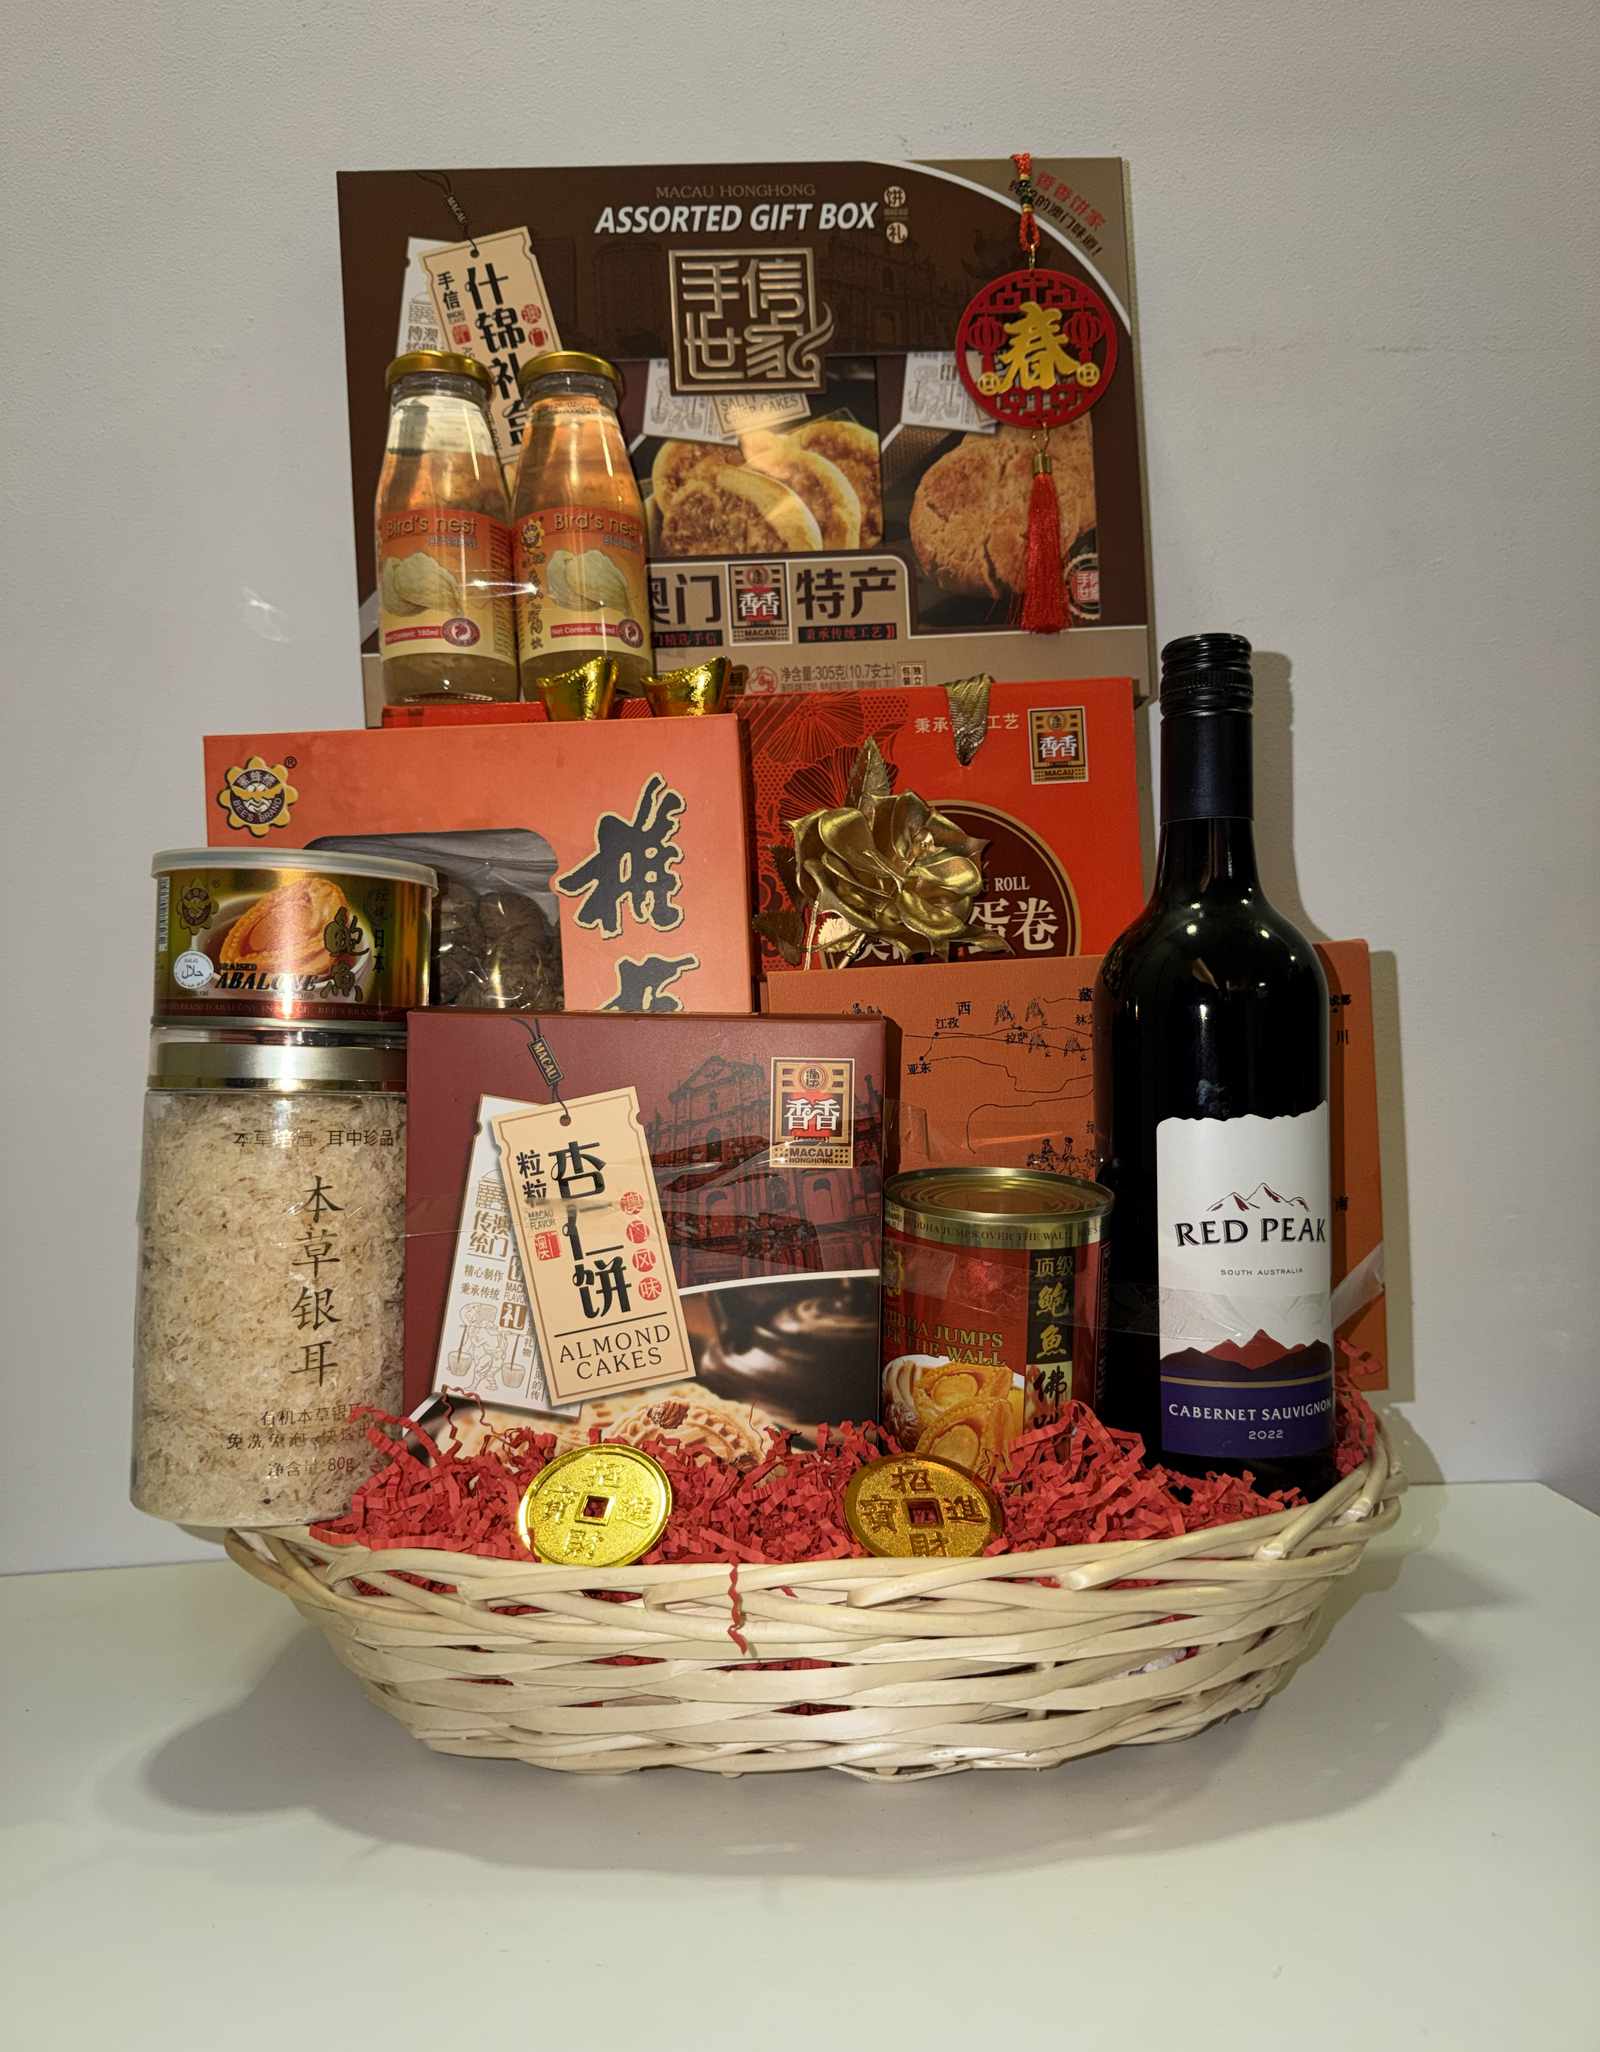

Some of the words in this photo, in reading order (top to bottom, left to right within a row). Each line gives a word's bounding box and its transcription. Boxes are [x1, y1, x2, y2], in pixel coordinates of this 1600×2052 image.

[656, 186, 714, 198] MACAU
[720, 184, 816, 197] HONGHONG
[447, 197, 467, 223] MACAU
[595, 205, 742, 233] ASSORTED
[750, 203, 812, 231] GIFT
[819, 202, 878, 230] BOX
[437, 271, 460, 310] 手信
[1000, 302, 1080, 393] 春
[761, 395, 798, 412] CAKES
[387, 515, 429, 538] Bird's
[436, 516, 477, 535] nest
[554, 513, 604, 531] Bird's
[429, 536, 477, 550] BEVERAGE
[739, 592, 779, 616] 香香
[796, 567, 897, 620] 特产
[418, 629, 439, 637] 180ml
[1040, 735, 1077, 758] 香香
[1045, 769, 1074, 777] MACAU
[259, 797, 282, 822] BRAND
[994, 877, 1030, 892] ROLL
[373, 929, 385, 973] 日本
[182, 964, 204, 979] حلال
[218, 963, 258, 971] BRAISED
[956, 1001, 971, 1015] 西
[1005, 1032, 1029, 1044] 拉萨
[1335, 1030, 1349, 1046] 川
[533, 1042, 559, 1080] MACAU
[907, 1062, 931, 1075] 亚东
[784, 1098, 840, 1131] 香香
[327, 1129, 394, 1147] 耳中珍品
[789, 1148, 833, 1157] MACAU
[528, 1209, 554, 1221] MACAU
[530, 1219, 557, 1230] FLAVOR
[548, 1141, 632, 1319] 杏仁饼
[905, 1216, 939, 1233] BUDDHA
[942, 1226, 978, 1238] JUMPS
[981, 1231, 1012, 1240] OVER
[1016, 1233, 1040, 1241] THE
[1043, 1231, 1070, 1240] WALL
[1174, 1219, 1248, 1247] RED
[1260, 1217, 1326, 1243] PEAK
[464, 1264, 503, 1282] 精心制作
[1035, 1256, 1074, 1278] 顶级
[1258, 1267, 1303, 1275] AUSTRALIA
[290, 1175, 344, 1387] 本草银耳
[460, 1282, 500, 1301] 秉承传统
[560, 1324, 670, 1363] ALMOND
[934, 1325, 1004, 1348] JUMPS
[905, 1334, 940, 1358] THE
[945, 1345, 1006, 1367] WALL
[577, 1347, 661, 1379] CAKES
[1169, 1402, 1255, 1421] CABERNET
[1262, 1397, 1331, 1421] SAUVIGNON
[1248, 1429, 1283, 1439] 2022
[327, 1456, 354, 1472] 80g
[890, 1467, 934, 1493] 招
[943, 1495, 988, 1525] 進
